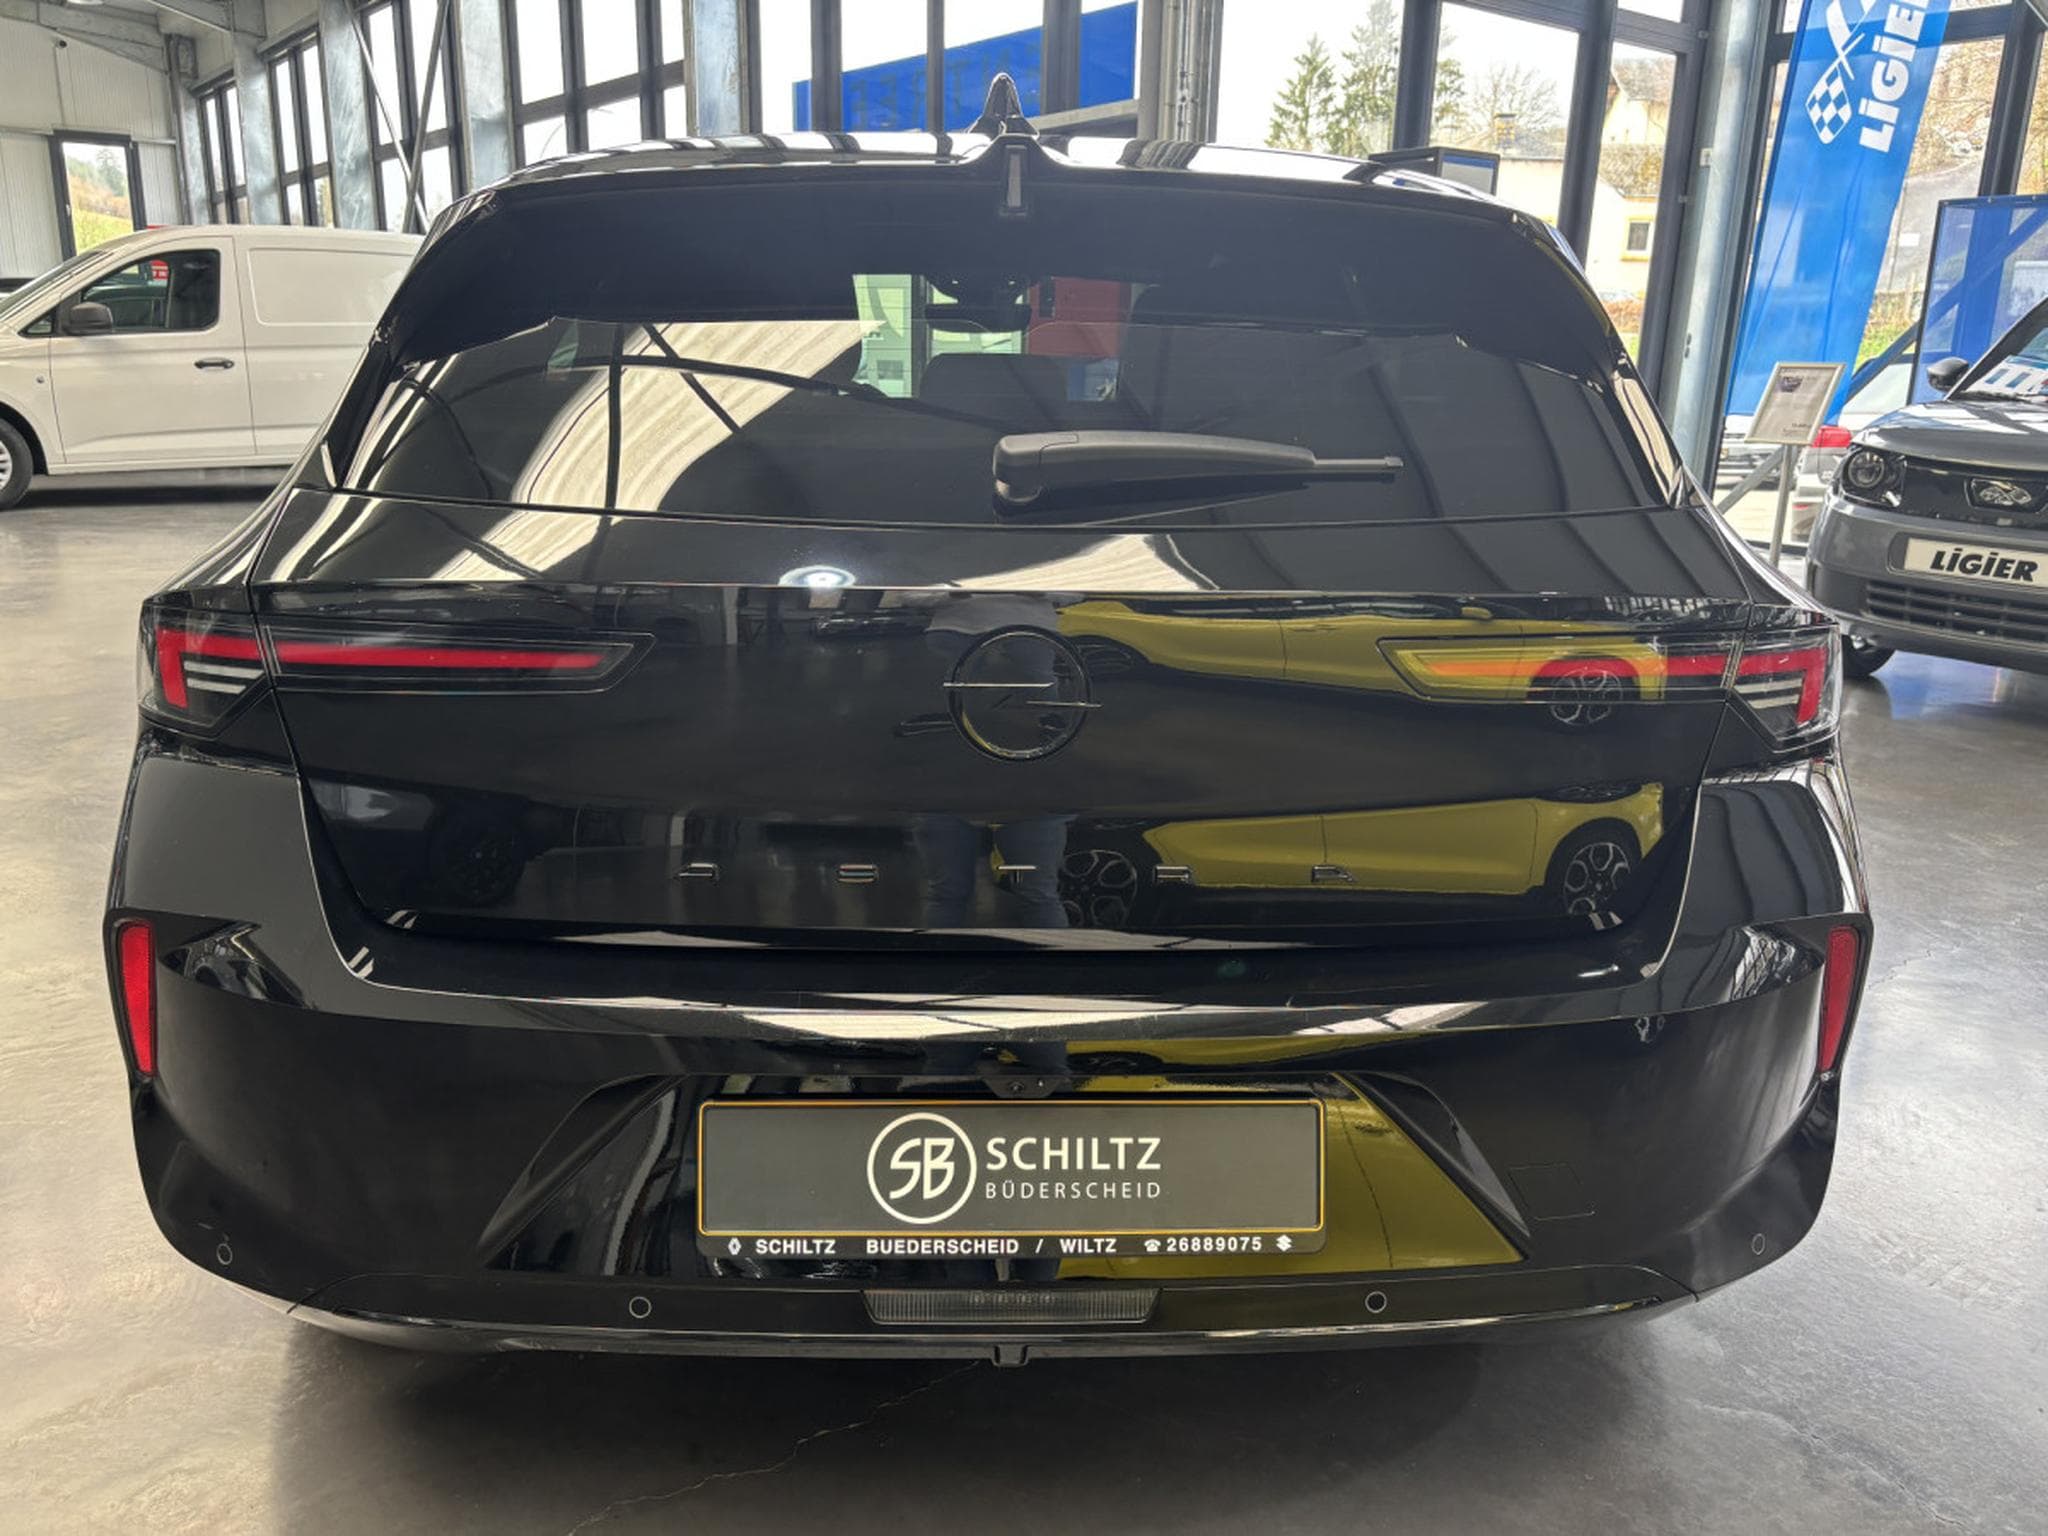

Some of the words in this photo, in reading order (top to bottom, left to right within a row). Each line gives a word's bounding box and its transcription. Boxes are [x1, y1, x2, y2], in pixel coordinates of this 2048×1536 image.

[986, 1137, 1161, 1171] SCHILTZ
[889, 1137, 955, 1200] SB
[985, 1179, 1161, 1199] BÜDERSCHEID
[755, 1238, 837, 1255] SCHILTZ
[866, 1238, 1020, 1254] BUEDERSCHEID
[1035, 1238, 1044, 1254] /
[1059, 1238, 1118, 1254] WILTZ
[1166, 1236, 1263, 1252] 26889075
